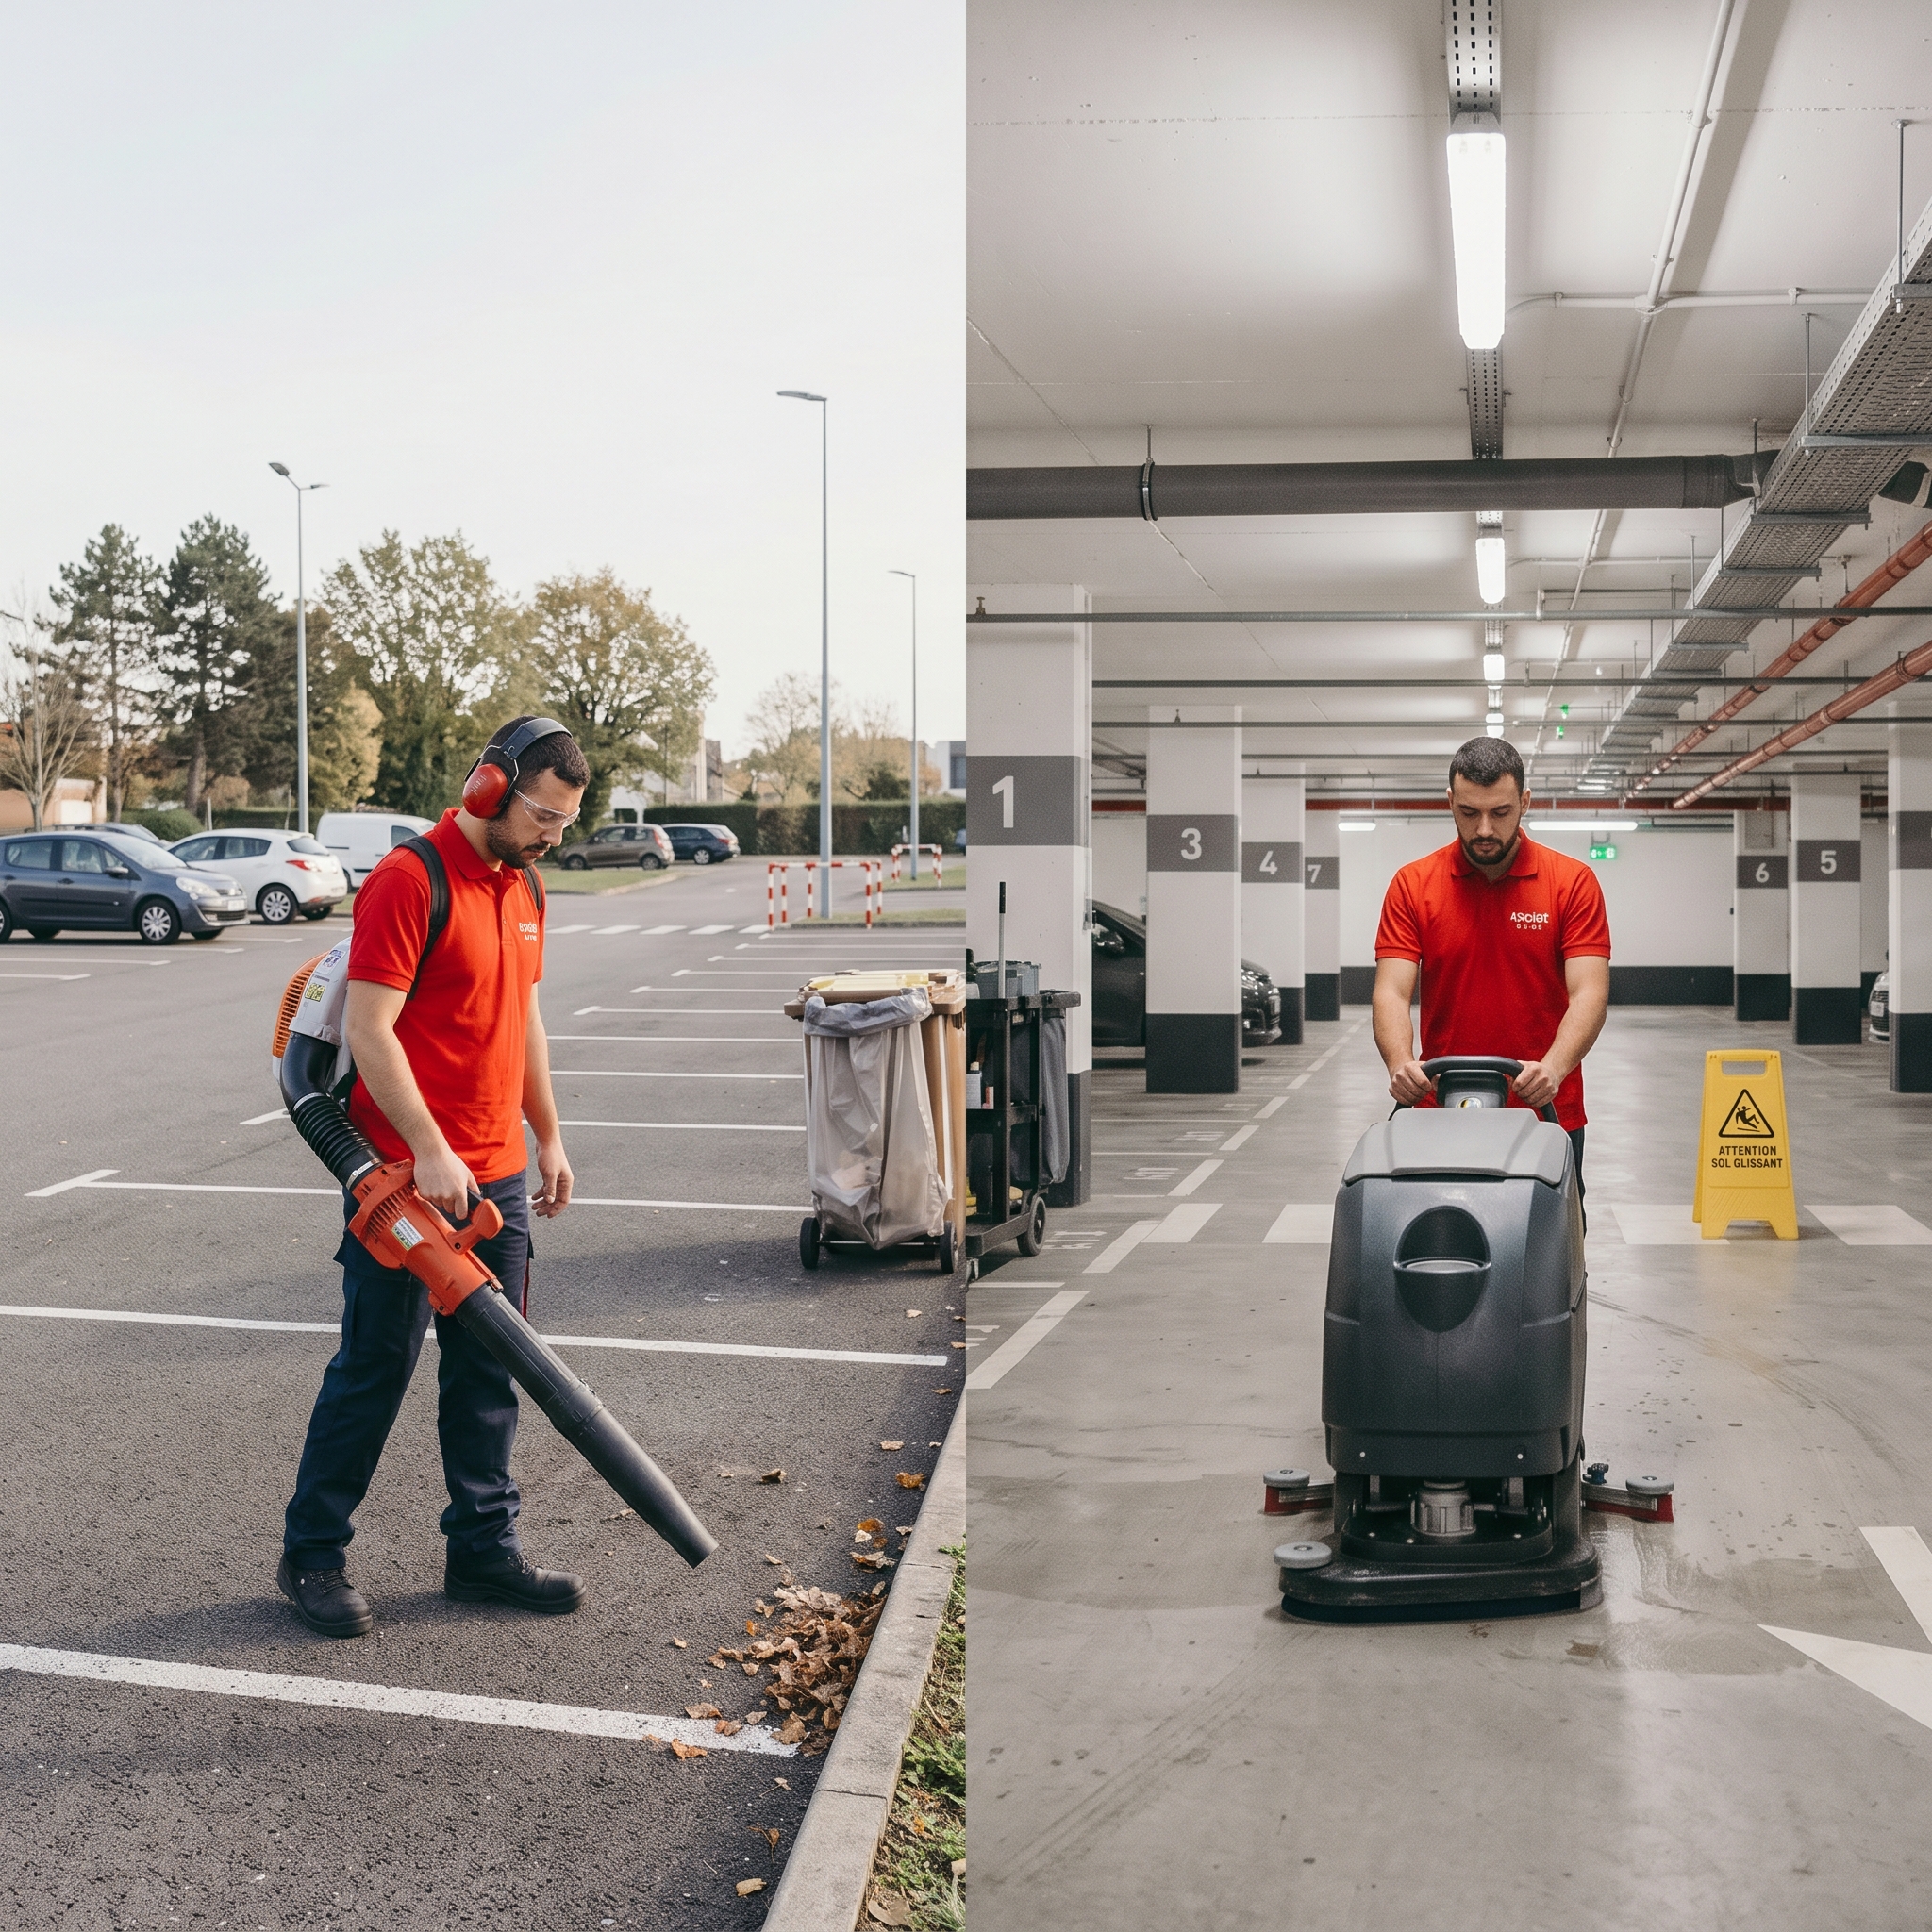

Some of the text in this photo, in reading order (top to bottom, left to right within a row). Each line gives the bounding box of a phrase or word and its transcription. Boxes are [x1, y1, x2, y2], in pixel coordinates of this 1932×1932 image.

[992, 775, 1014, 828] 1
[1180, 827, 1203, 860] 3
[1259, 851, 1278, 875] 4
[1756, 862, 1770, 883] 6
[1821, 850, 1837, 874] 5
[1307, 864, 1323, 883] 7
[1719, 1146, 1777, 1156] ATTENTION
[1711, 1158, 1783, 1169] SOL GLISSANT
